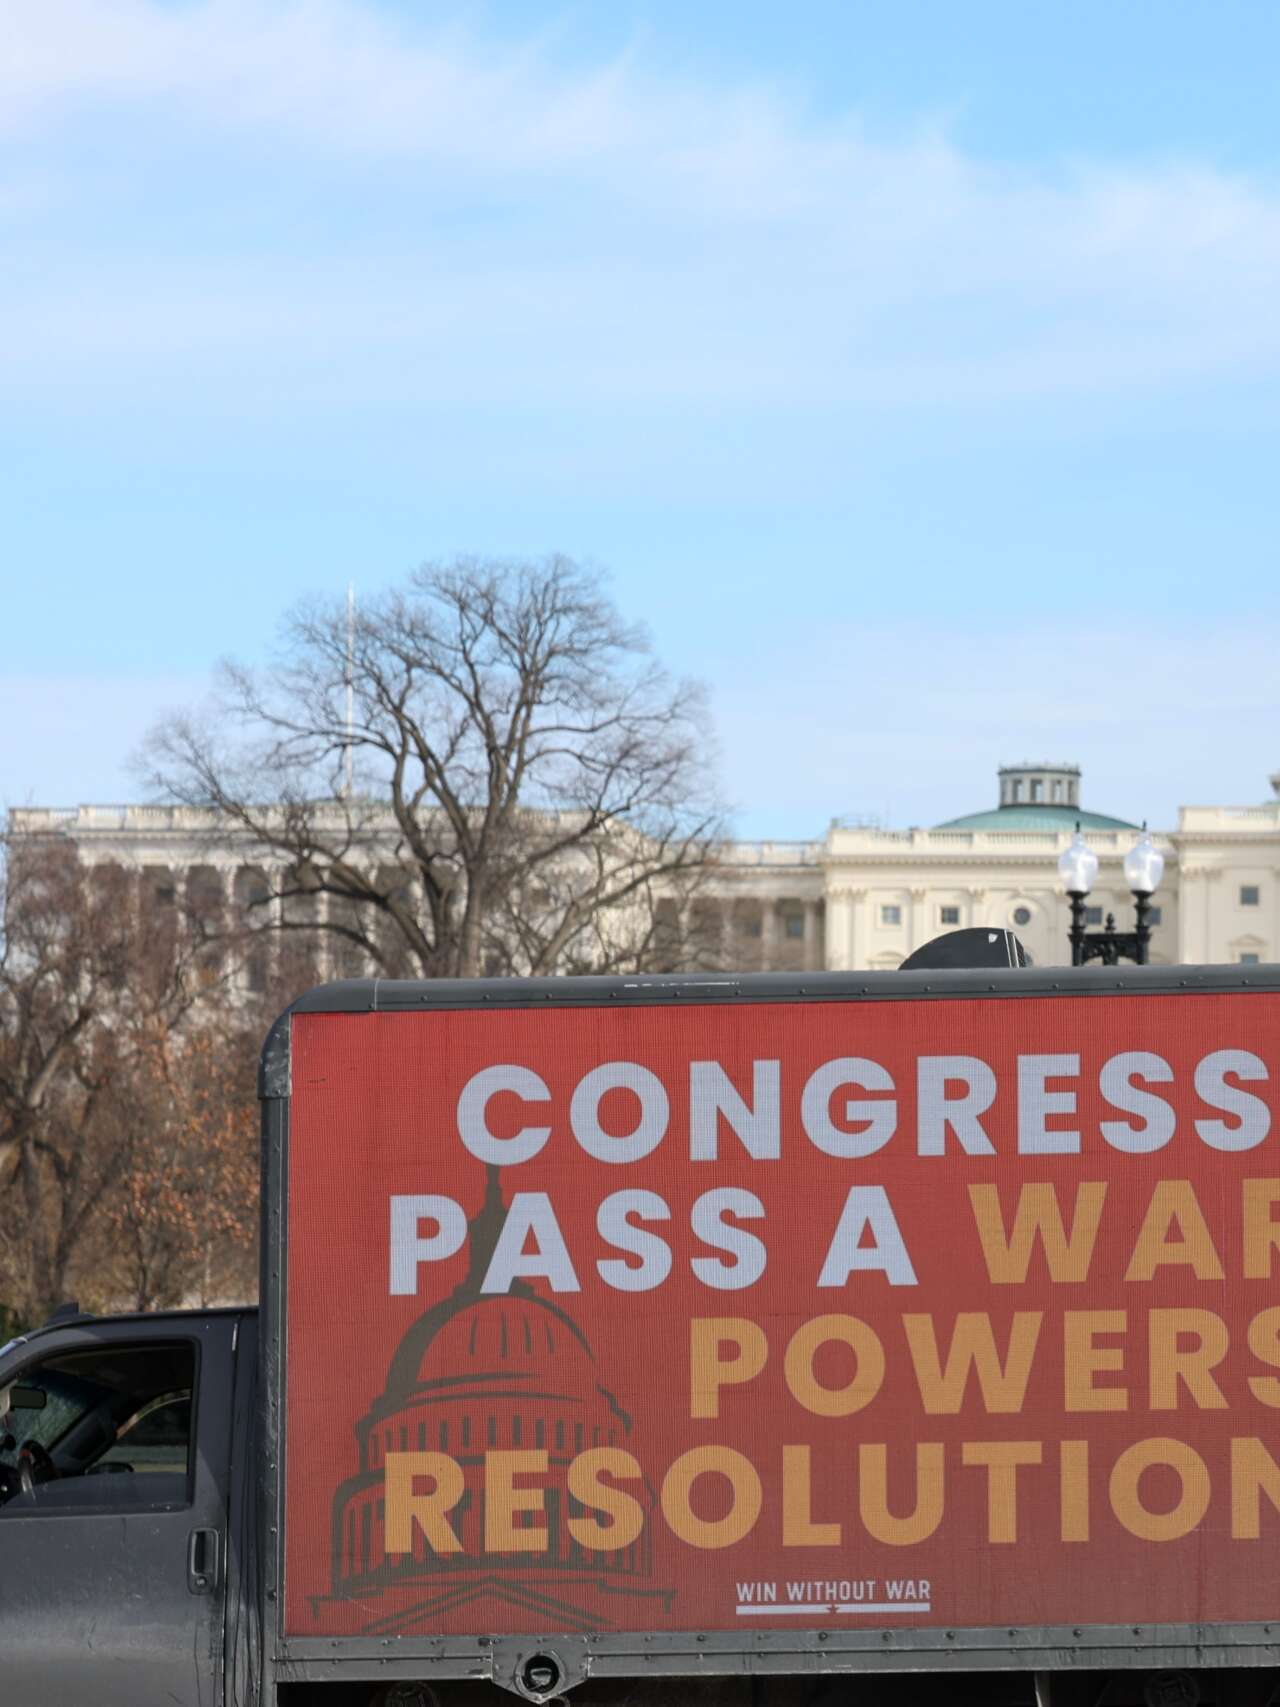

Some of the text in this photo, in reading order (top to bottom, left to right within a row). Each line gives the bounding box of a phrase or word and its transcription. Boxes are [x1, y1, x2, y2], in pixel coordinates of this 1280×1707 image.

[388, 1187, 767, 1295] PASS
[817, 1185, 918, 1286] A
[736, 1579, 931, 1602] WIN WITHOUT WAR
